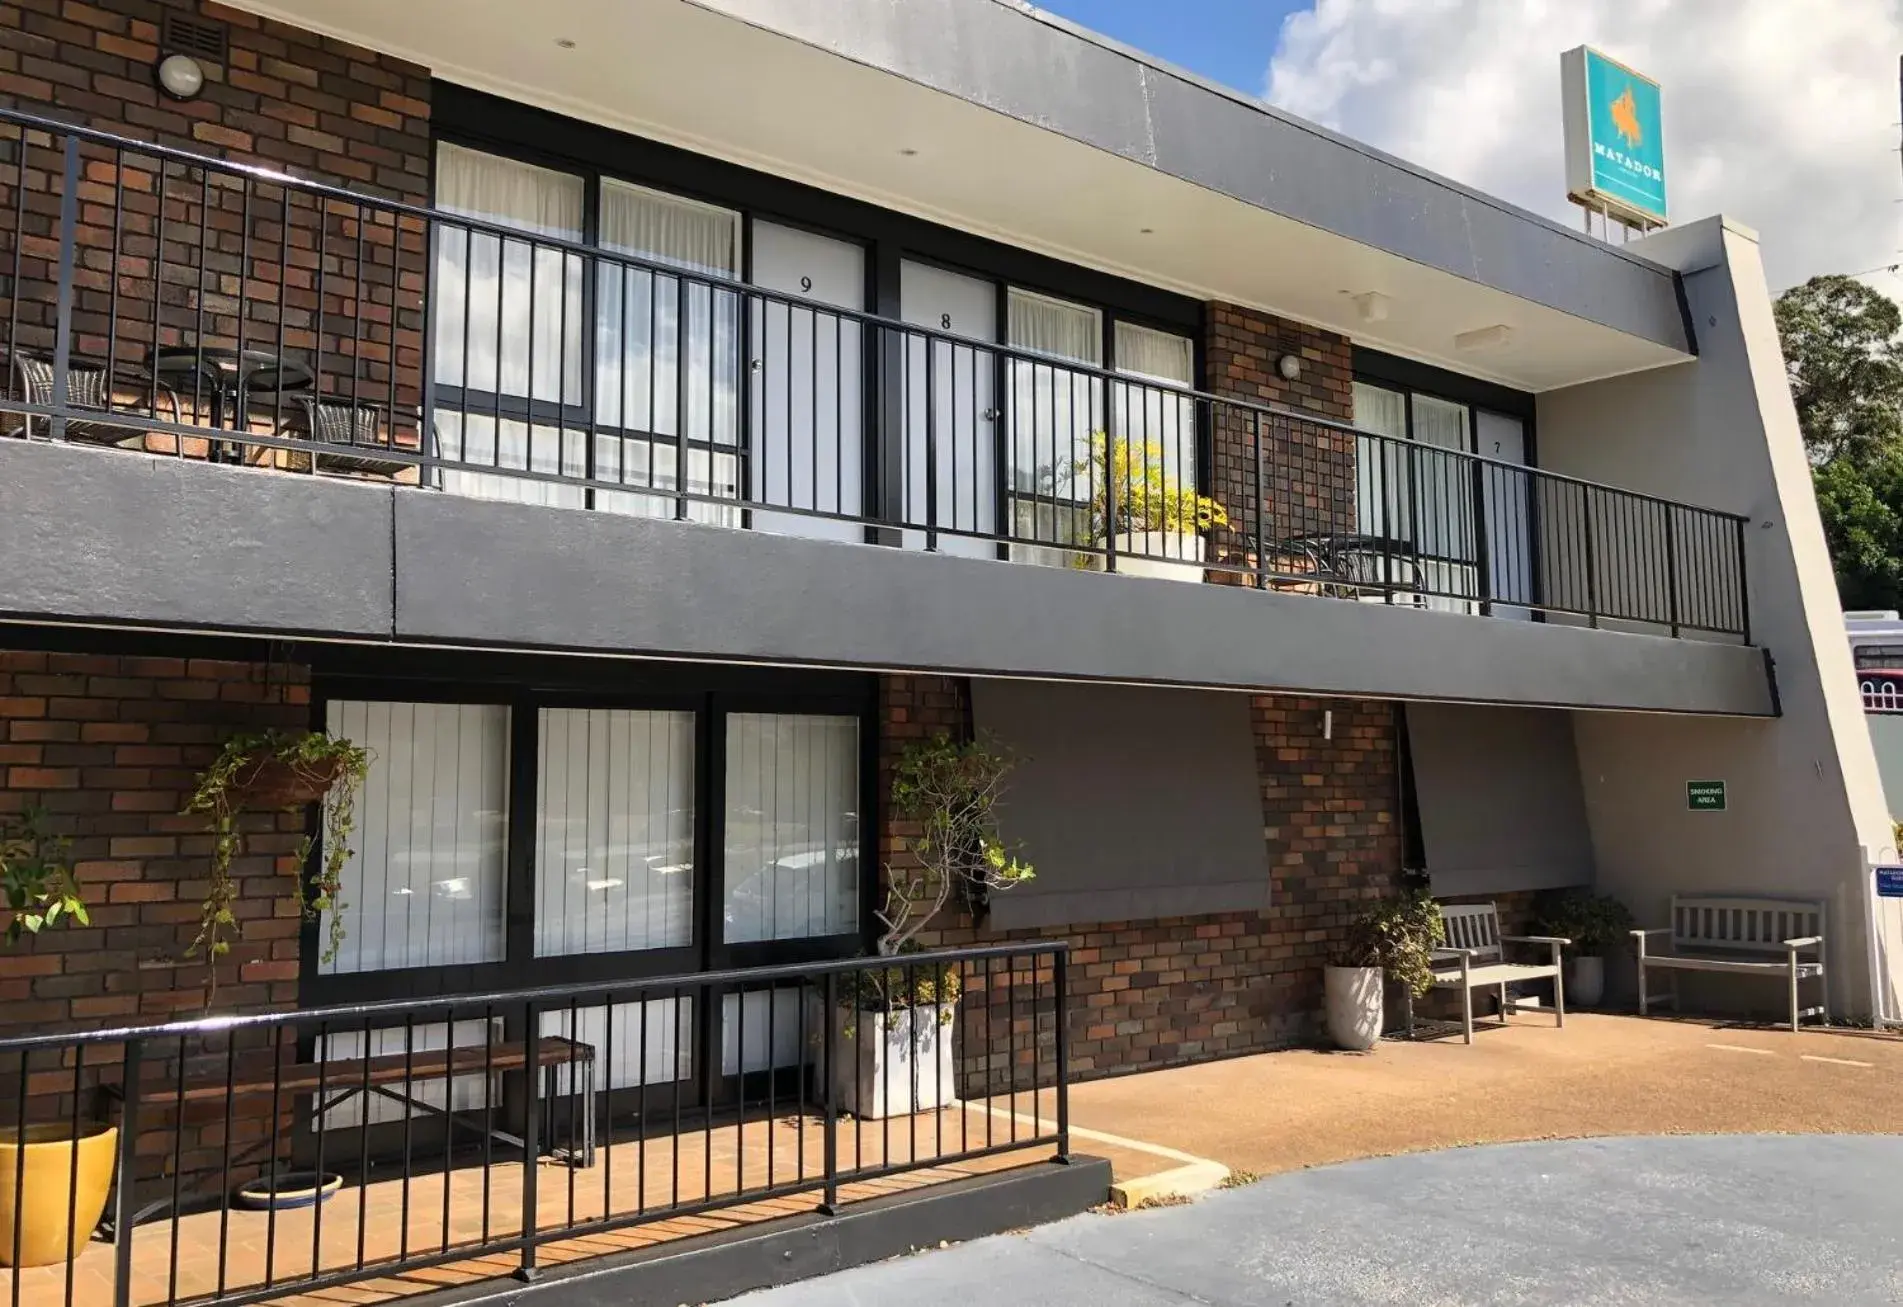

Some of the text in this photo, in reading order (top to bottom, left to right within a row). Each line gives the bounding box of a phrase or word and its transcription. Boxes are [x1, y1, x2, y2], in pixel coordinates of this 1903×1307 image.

[1594, 141, 1661, 182] MATADOR
[800, 275, 812, 293] 9
[941, 313, 951, 330] 8
[1494, 440, 1501, 454] 7
[1690, 788, 1723, 796] SMOKING
[1697, 796, 1716, 804] AREA
